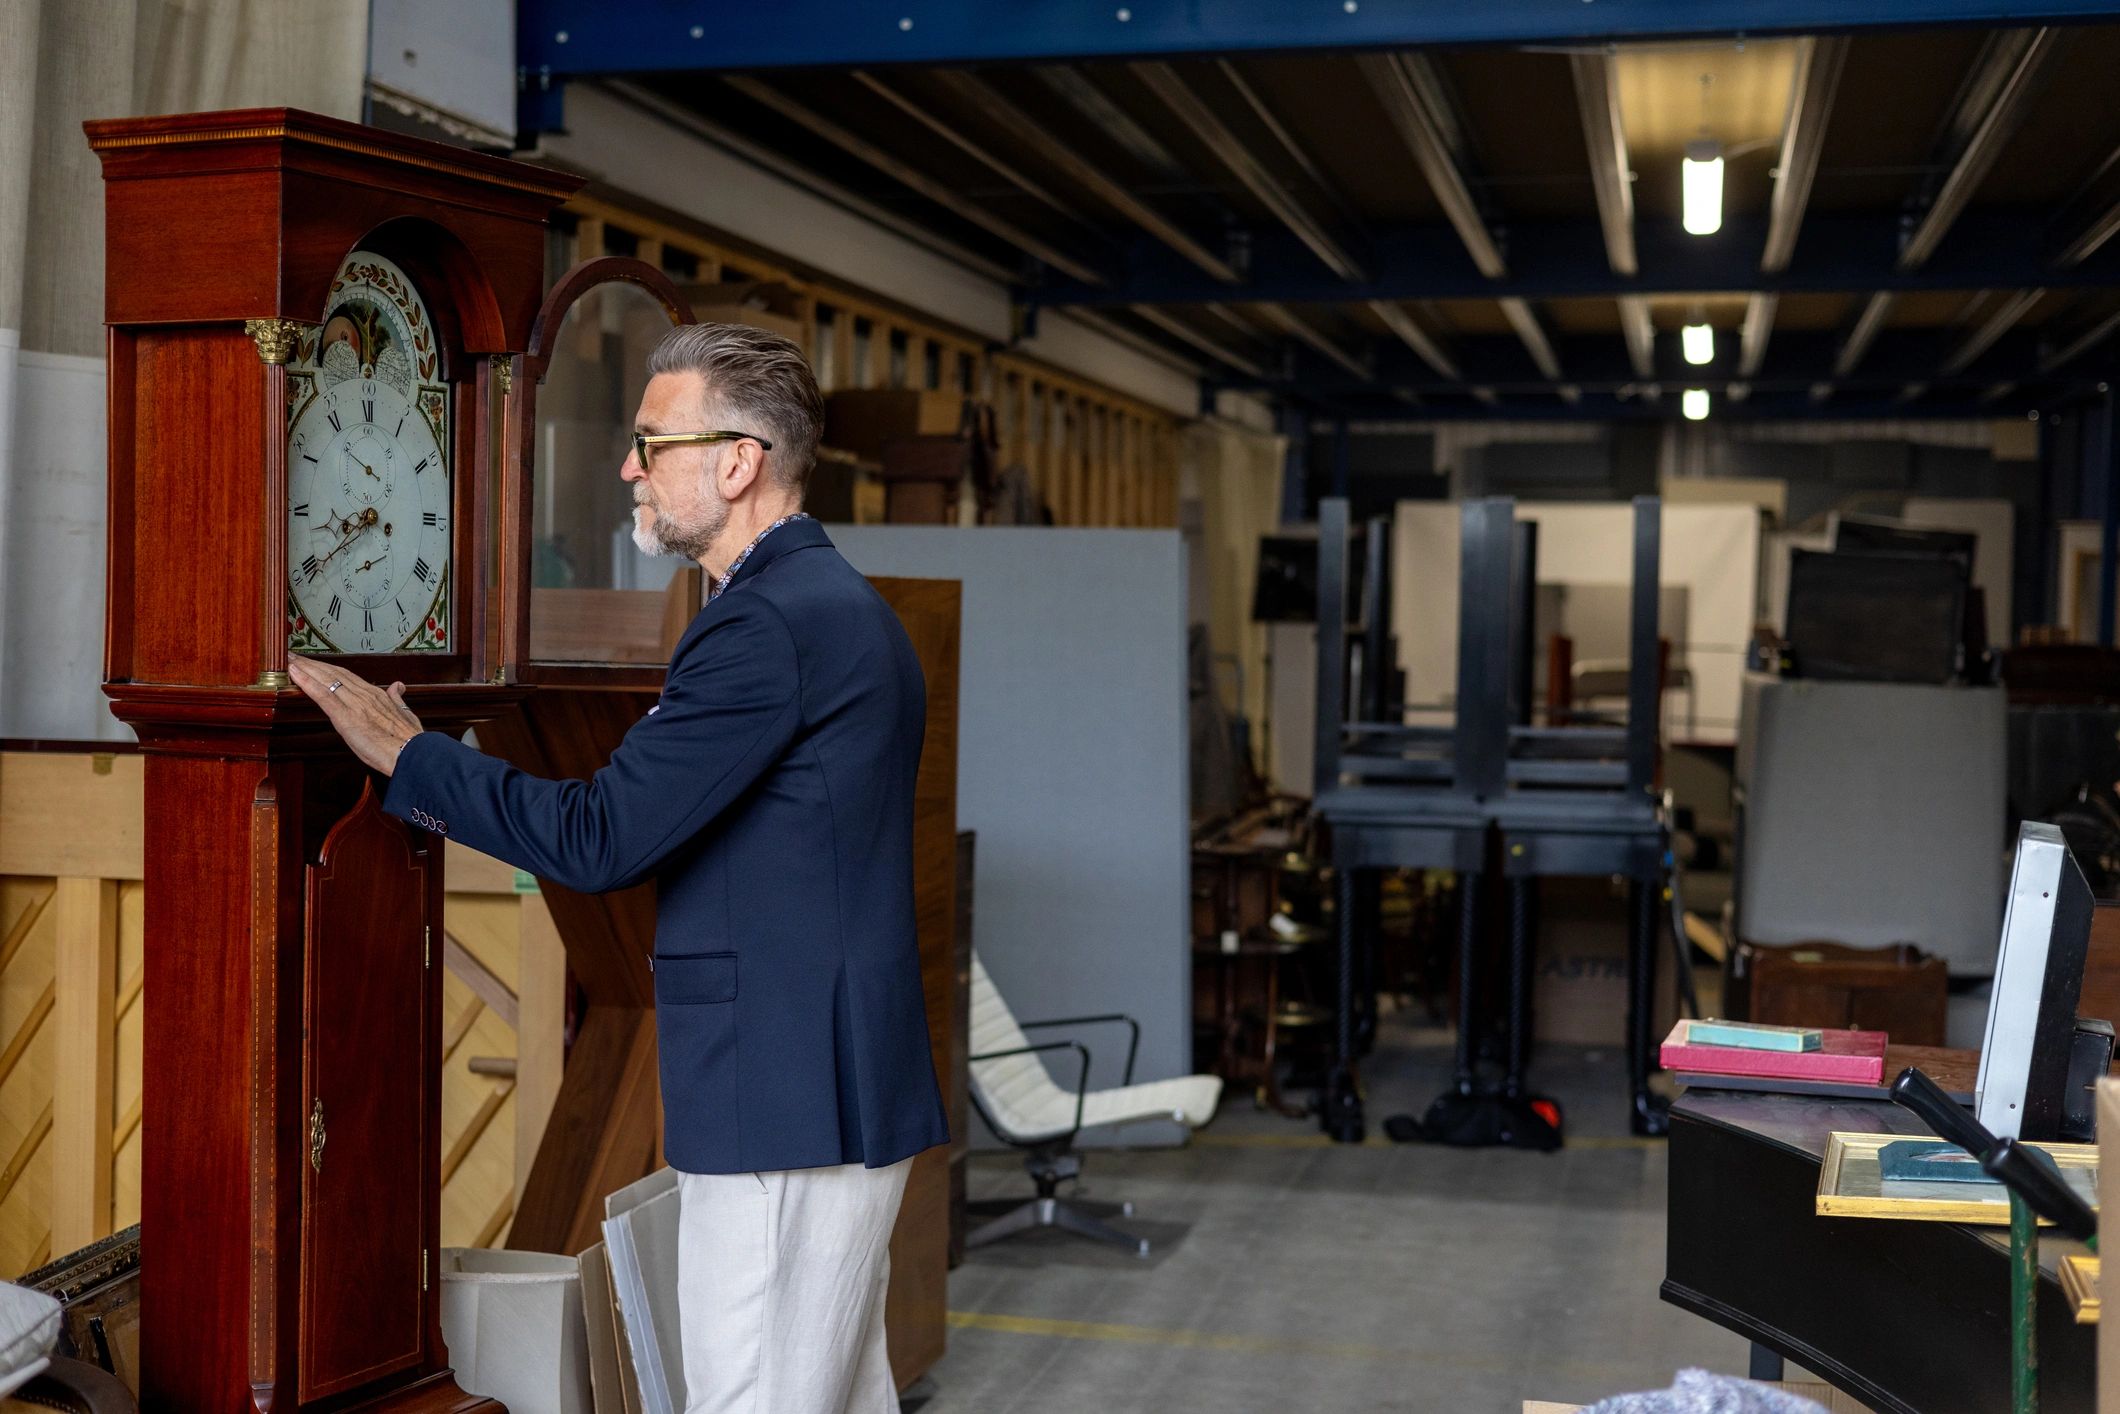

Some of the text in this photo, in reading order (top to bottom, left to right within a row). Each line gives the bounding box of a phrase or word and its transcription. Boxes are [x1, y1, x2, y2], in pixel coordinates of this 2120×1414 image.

[362, 381, 376, 396] 60
[324, 392, 337, 410] 55
[402, 404, 410, 416] 5
[364, 427, 373, 436] 60
[293, 432, 305, 453] 50
[429, 450, 438, 466] 10
[415, 458, 428, 474] II
[423, 512, 436, 526] III
[438, 517, 446, 532] 15
[426, 570, 438, 592] 20
